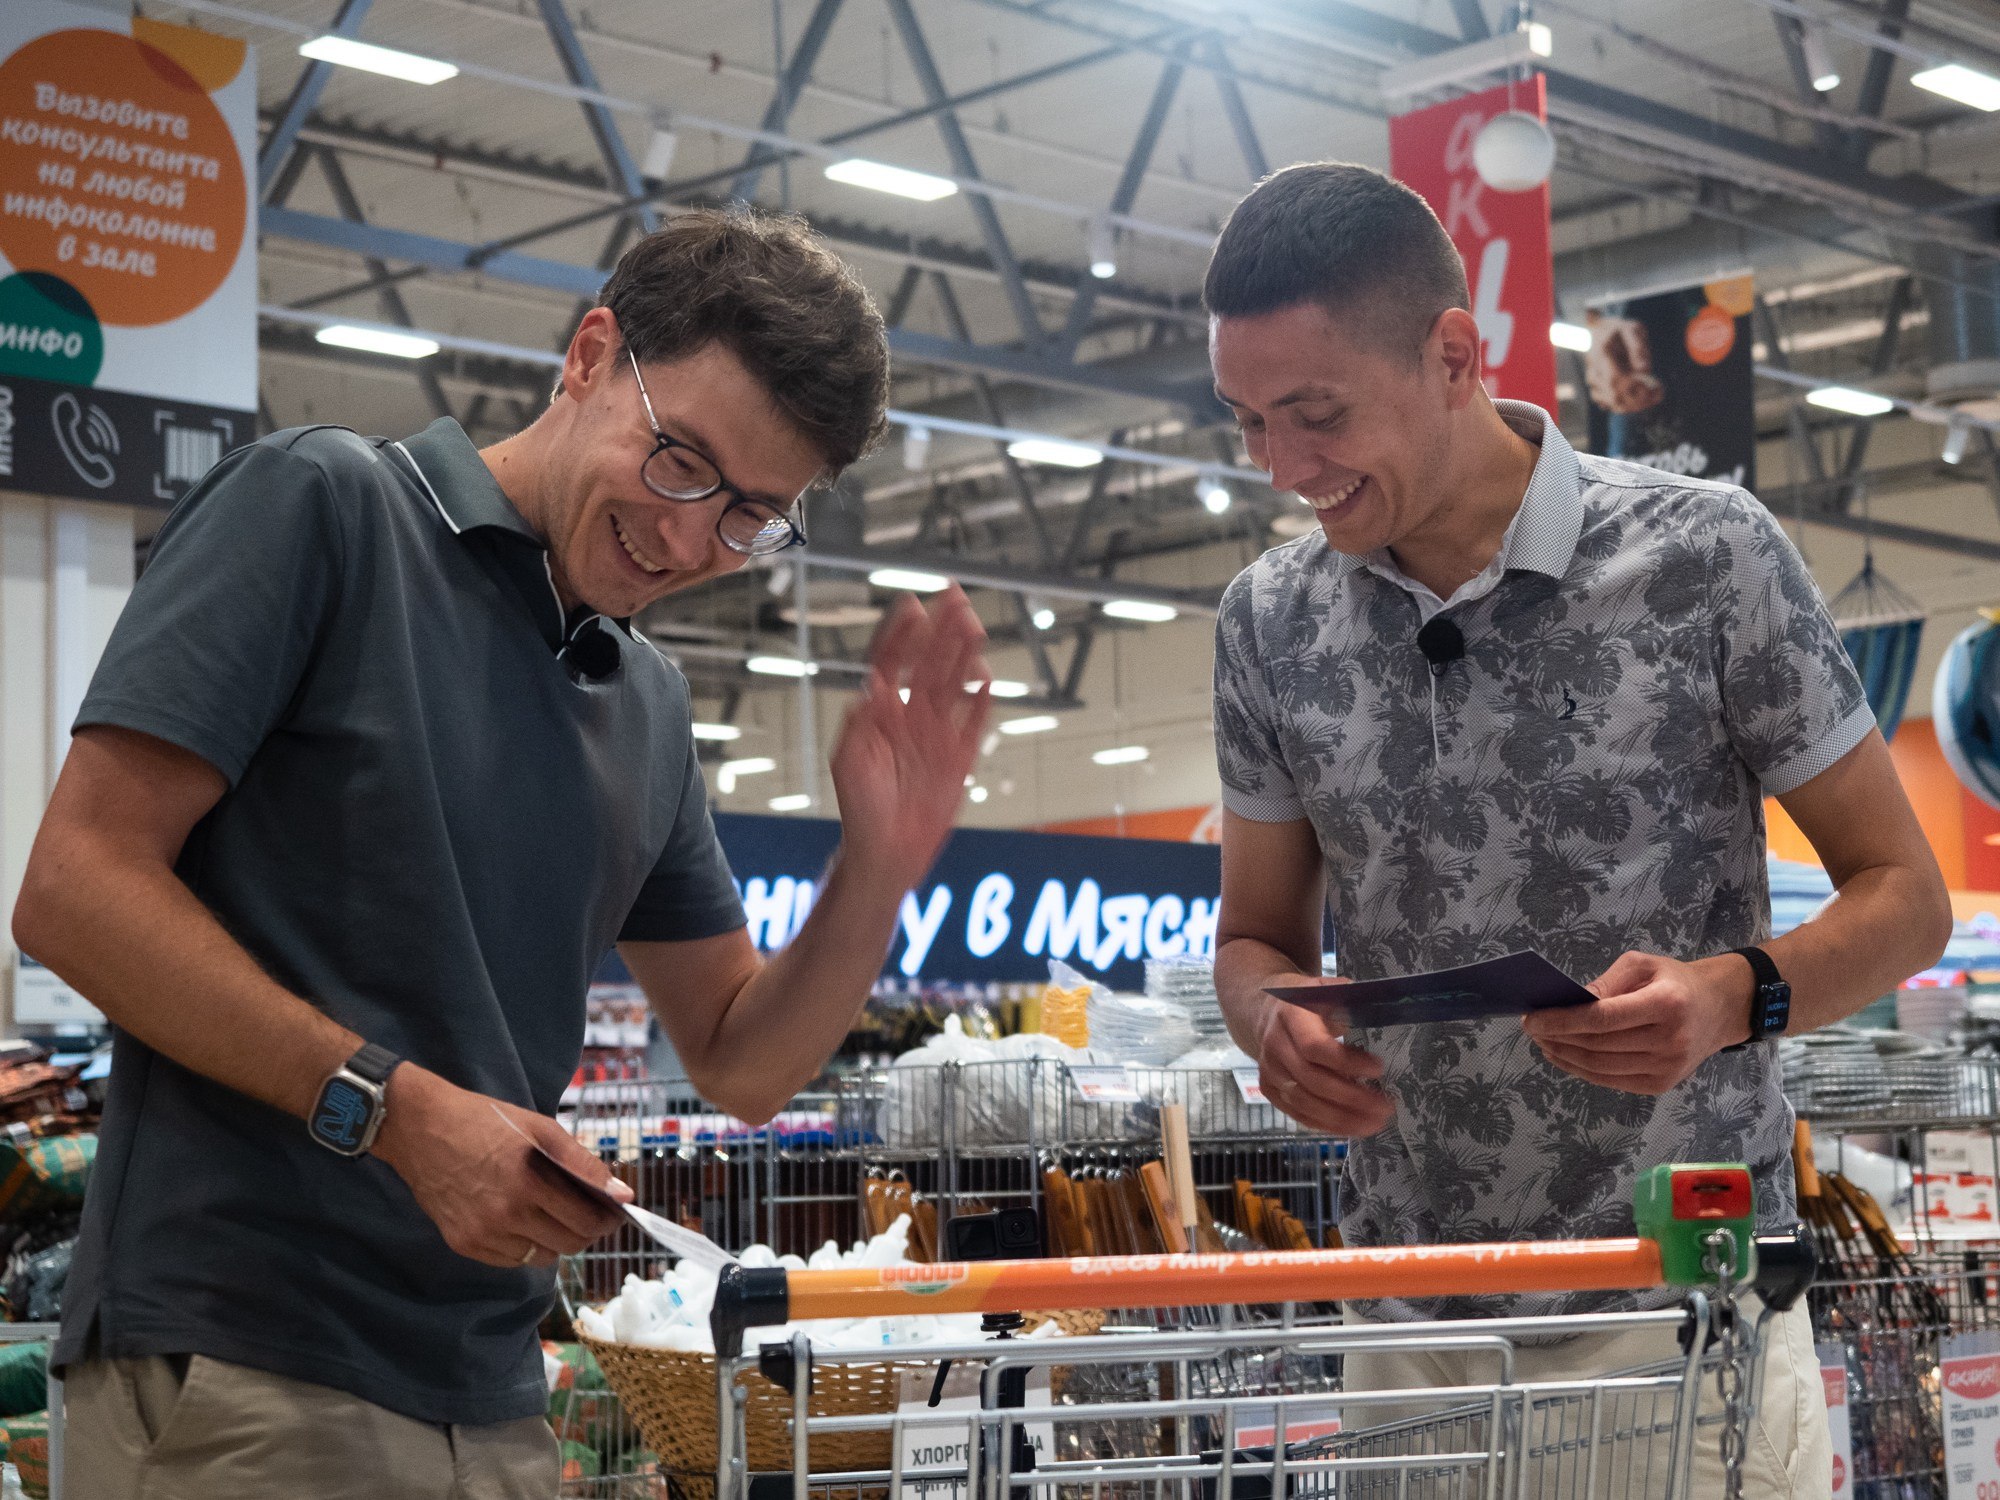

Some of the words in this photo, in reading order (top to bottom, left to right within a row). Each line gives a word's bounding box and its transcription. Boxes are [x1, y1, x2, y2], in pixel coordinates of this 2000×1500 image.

[35, 81, 189, 139] Вызовите
[0, 118, 220, 181] консультанта
[37, 162, 77, 188] на
[82, 170, 187, 210] любой
[2, 192, 217, 252] инфоколонне
[57, 233, 77, 262] в
[82, 242, 158, 278] зале
